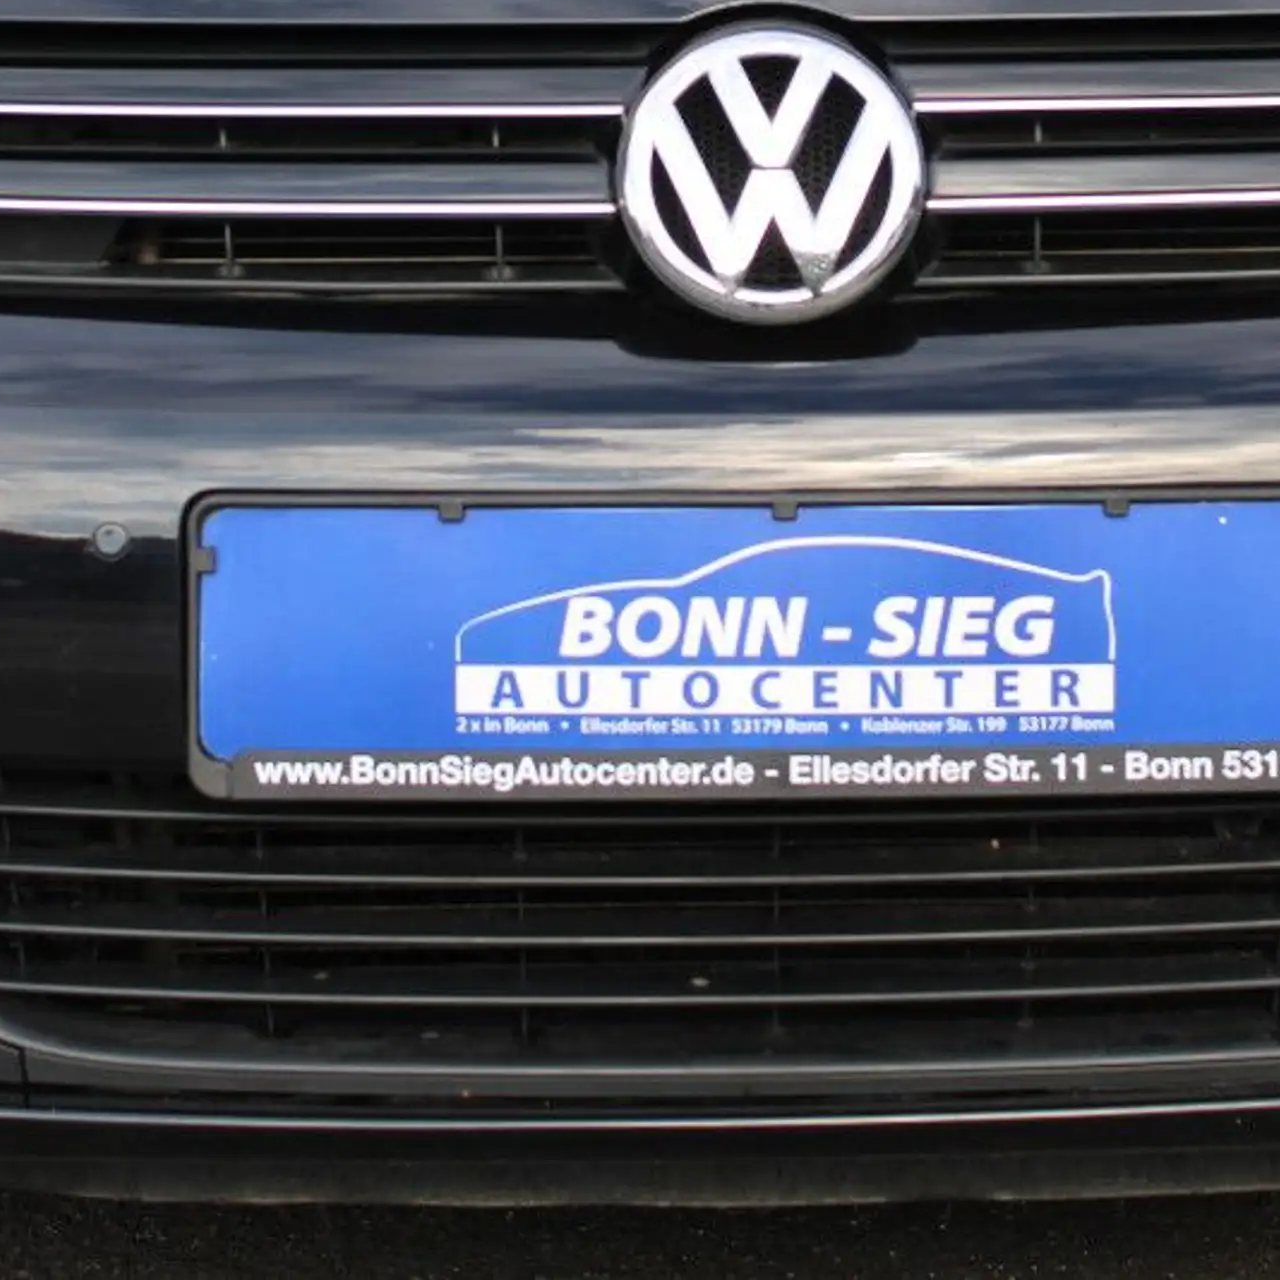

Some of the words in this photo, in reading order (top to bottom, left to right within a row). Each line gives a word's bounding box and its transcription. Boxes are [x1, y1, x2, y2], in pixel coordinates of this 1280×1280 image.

[558, 596, 808, 658] BONN
[867, 596, 1055, 658] SIEG
[490, 669, 1081, 710] AUTOCENTER
[504, 716, 550, 734] Bonn
[580, 716, 669, 735] Ellesdorfer
[731, 717, 783, 734] 53179
[784, 716, 829, 734] Bonn
[1019, 715, 1069, 732] 53177
[1070, 714, 1116, 732] Bonn
[253, 752, 755, 792] www.BonnSiegAutocenter.de
[788, 754, 977, 785] Ellesdorfer
[983, 751, 1041, 783] Str.
[1050, 752, 1089, 782] 11
[1123, 749, 1215, 781] Bonn
